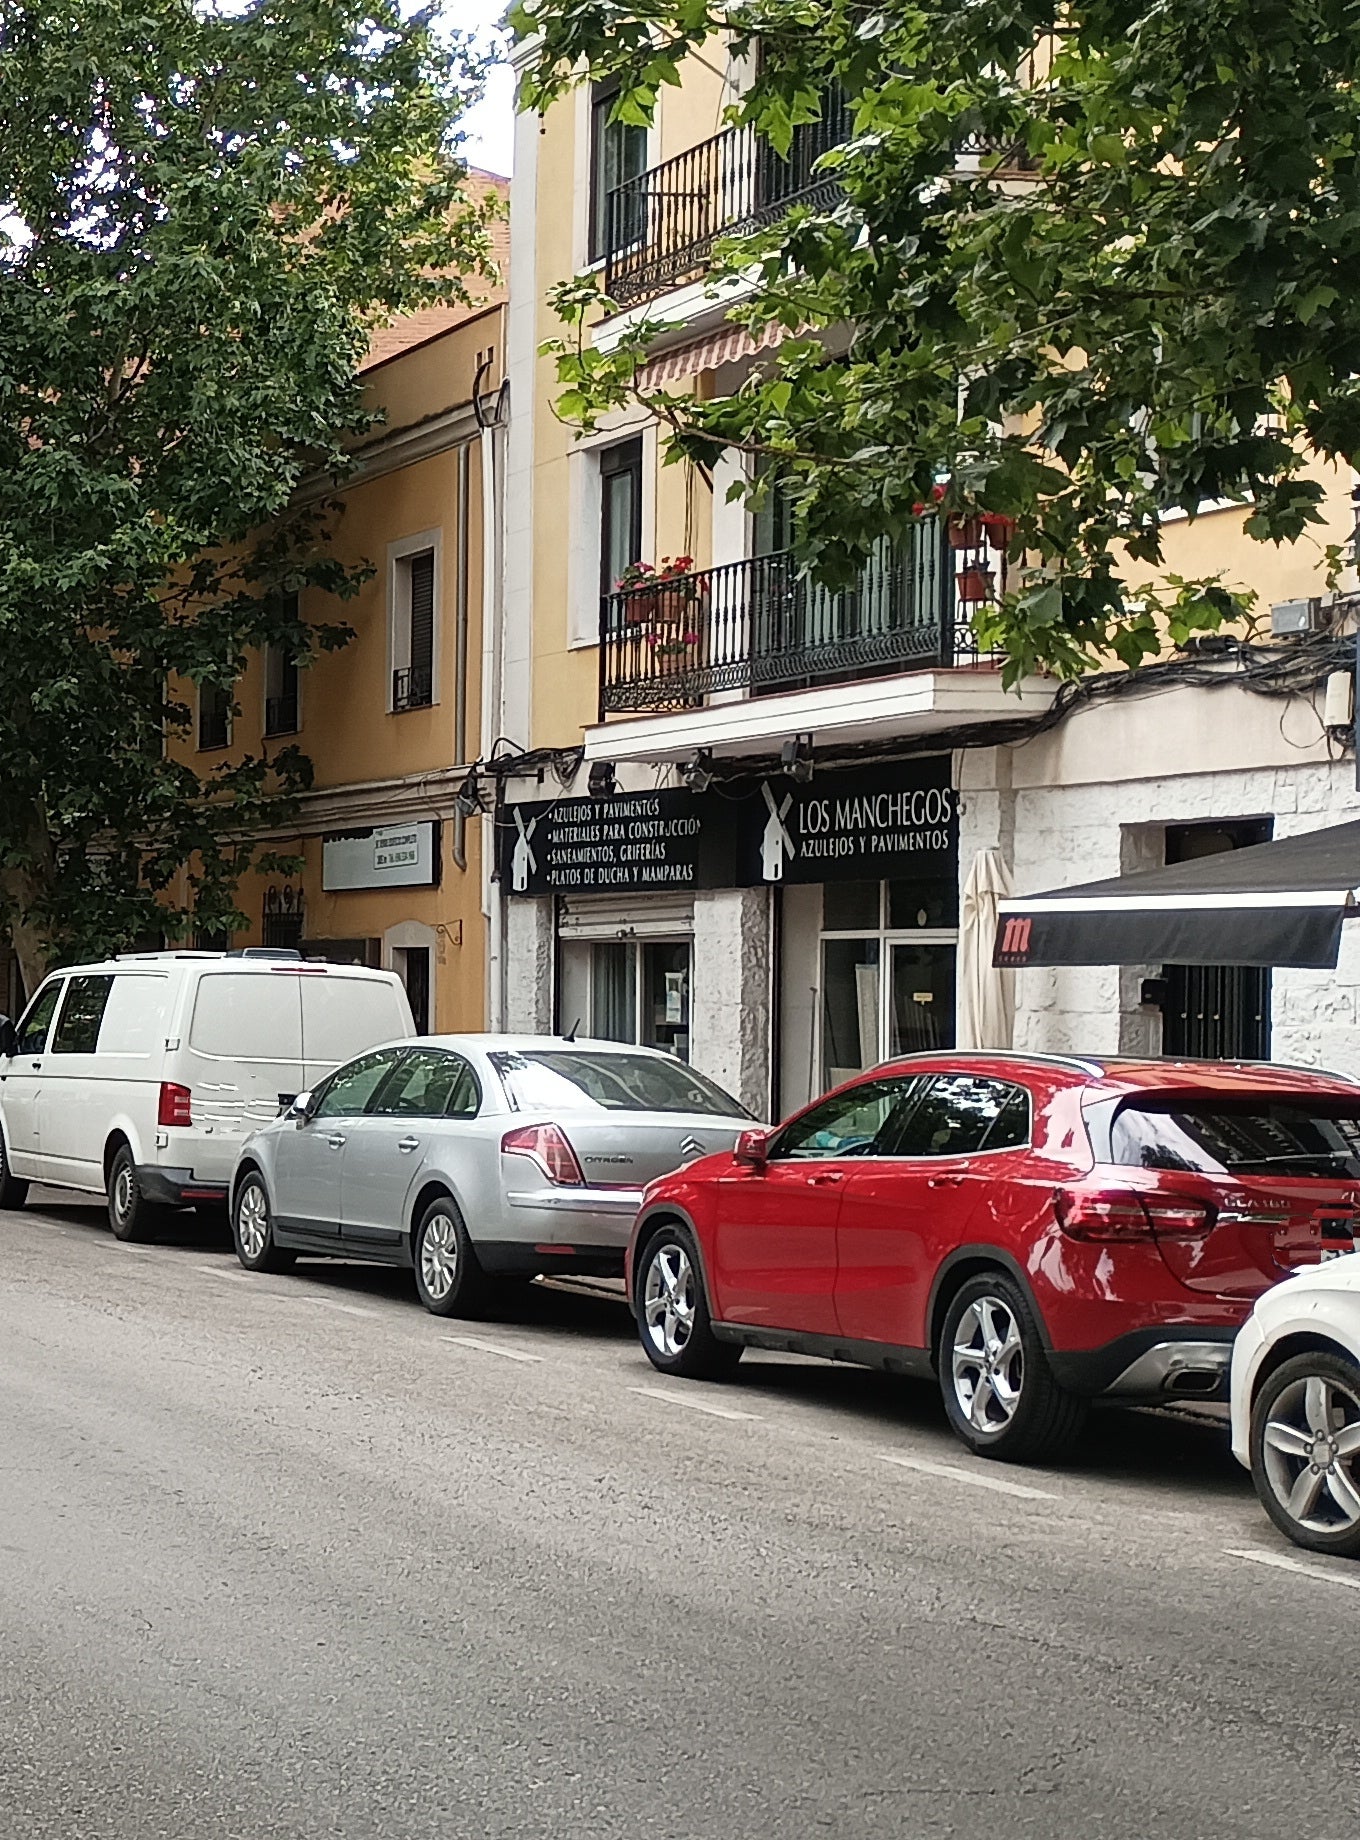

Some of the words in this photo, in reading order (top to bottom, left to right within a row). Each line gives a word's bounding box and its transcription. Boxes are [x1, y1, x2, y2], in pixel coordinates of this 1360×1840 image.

[553, 804, 592, 824] AZULEJOS
[595, 804, 600, 819] Y
[603, 799, 660, 818] PAVIMENTOS
[799, 799, 830, 834] LOS
[835, 788, 951, 831] MANCHEGOS
[552, 825, 600, 843] MATERIALES
[603, 823, 625, 840] PARA
[800, 836, 854, 859] AZULEJOS
[859, 836, 866, 853] Y
[871, 830, 949, 853] PAVIMENTOS
[551, 846, 617, 864] SANEAMIENTOS,
[620, 840, 666, 862] GRIFERÍAS
[551, 868, 581, 885] PLATOS
[584, 868, 595, 884] DE
[598, 866, 629, 884] DUCHA
[632, 866, 638, 882] Y
[642, 864, 693, 881] MAMPARAS
